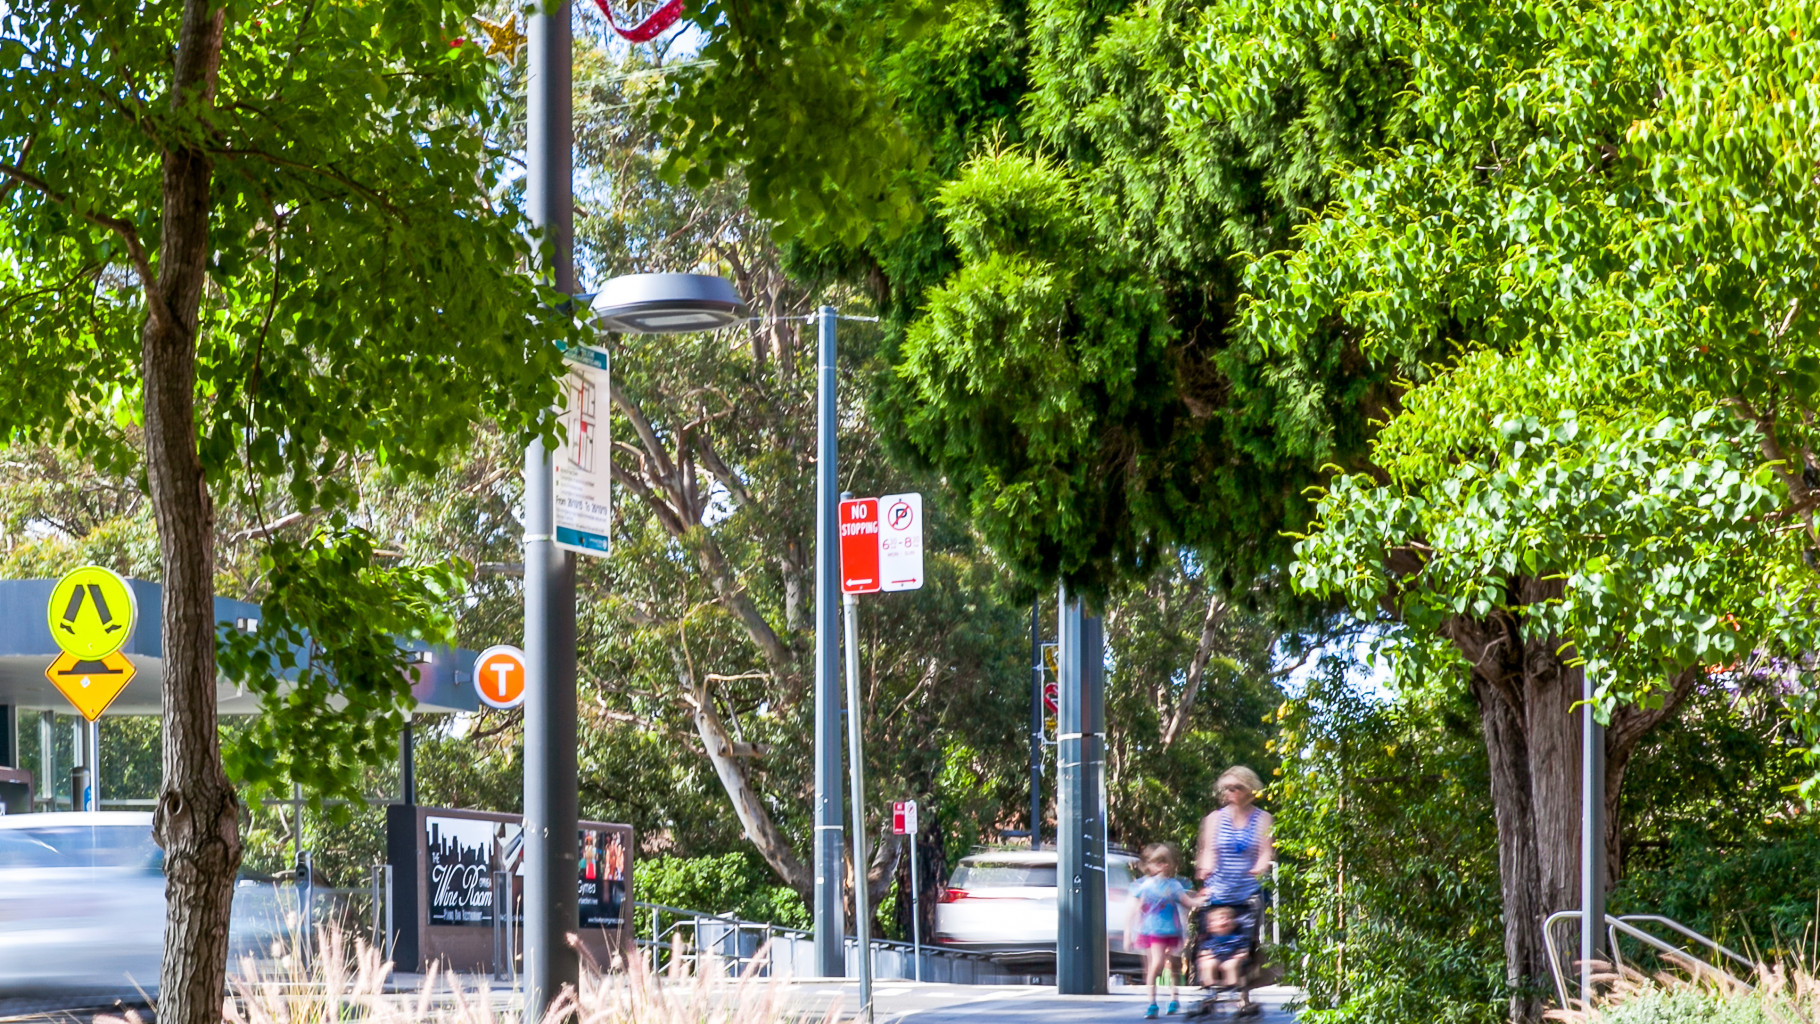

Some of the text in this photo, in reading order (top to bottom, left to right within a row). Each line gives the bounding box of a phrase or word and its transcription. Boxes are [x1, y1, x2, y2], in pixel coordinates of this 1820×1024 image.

[851, 504, 867, 520] NO
[841, 521, 879, 536] STOPPING
[490, 663, 514, 696] T
[432, 864, 493, 906] Wine Room
